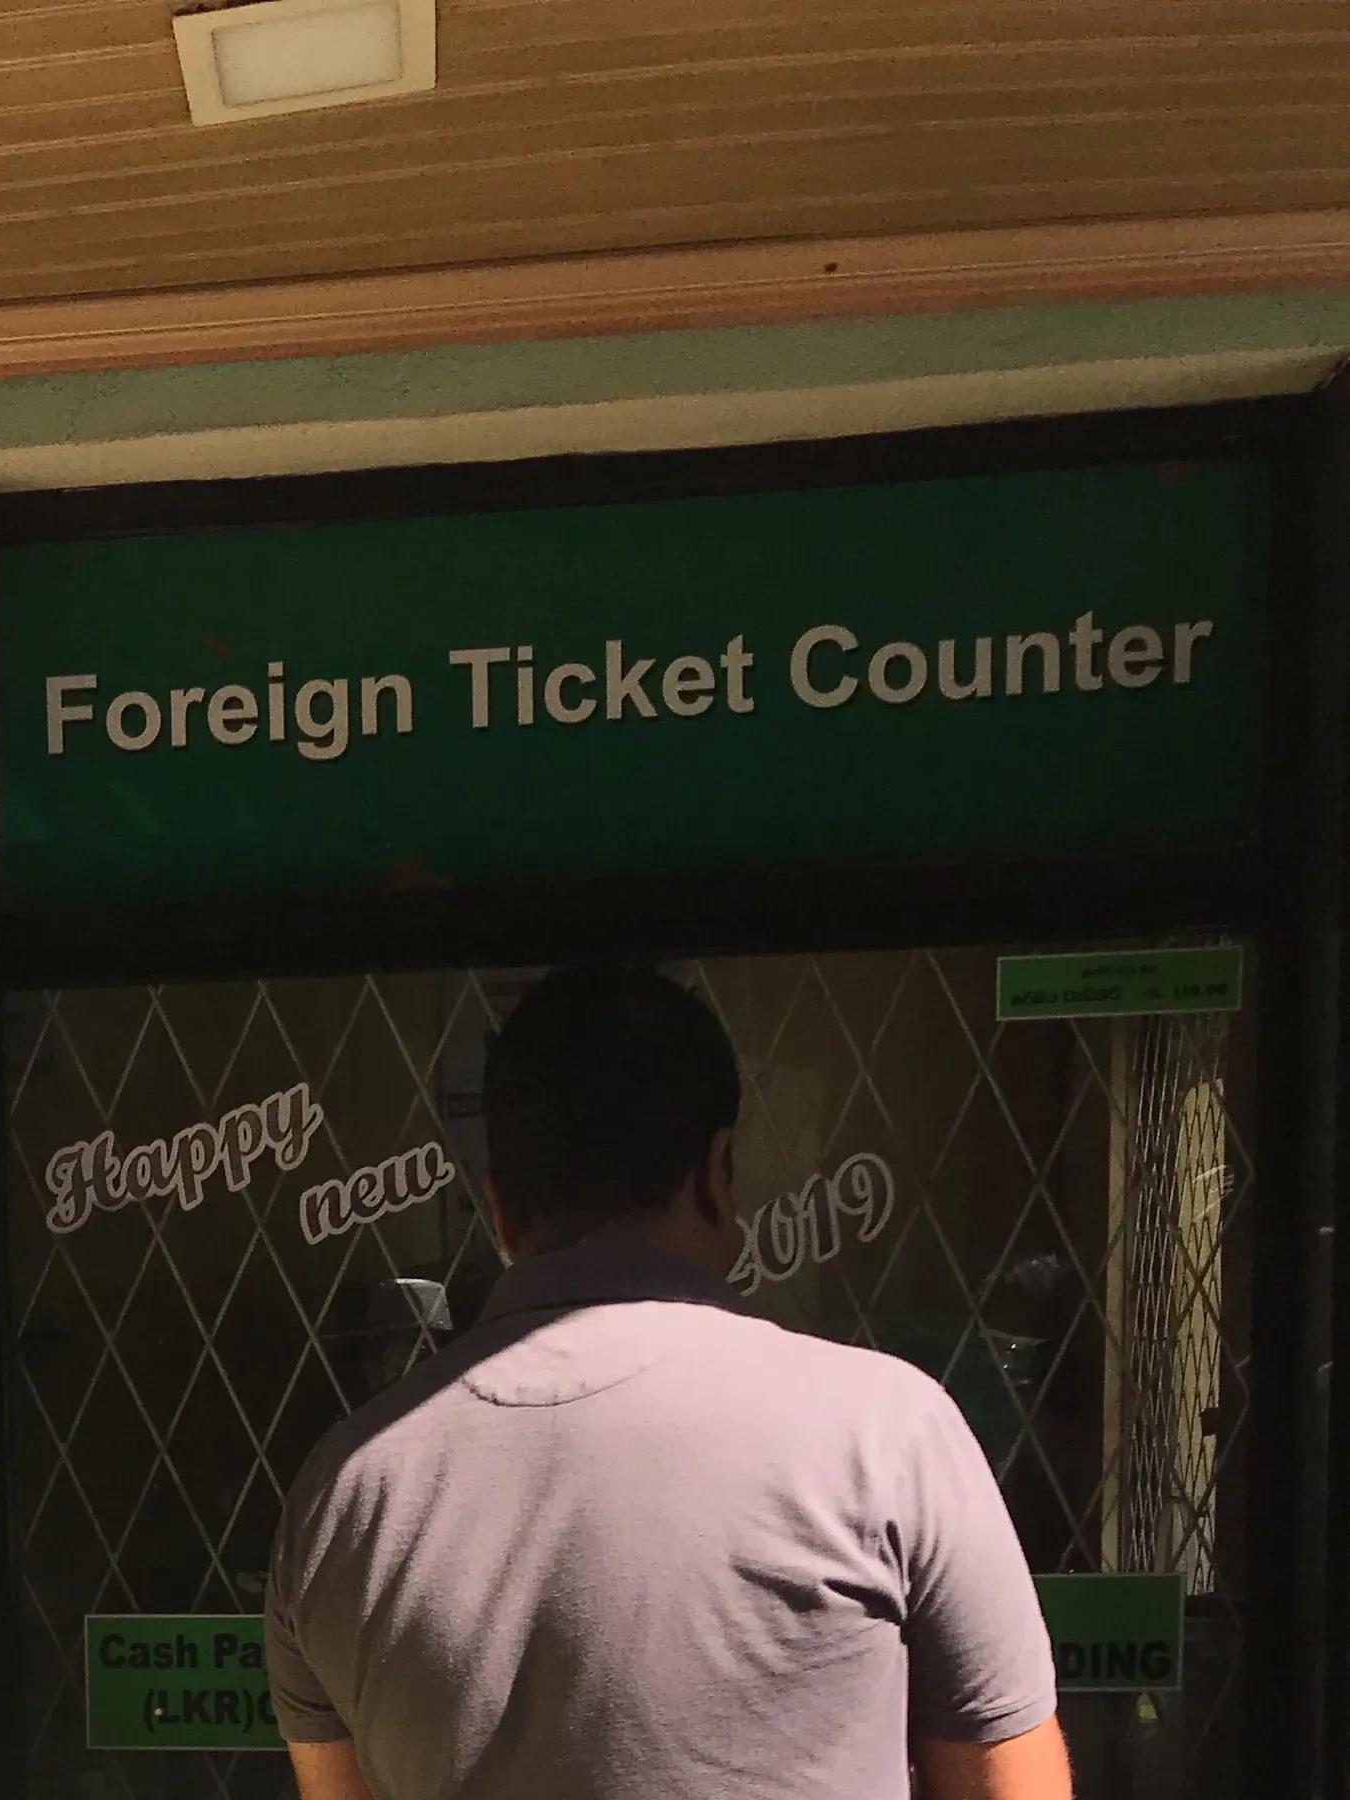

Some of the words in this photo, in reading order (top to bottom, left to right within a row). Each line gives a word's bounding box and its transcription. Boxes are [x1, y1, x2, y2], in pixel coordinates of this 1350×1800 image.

[46, 661, 413, 761] Foreign
[449, 634, 754, 729] Ticket
[789, 611, 1214, 709] Counter
[45, 1082, 324, 1234] Happy
[299, 1141, 456, 1245] new
[100, 1633, 199, 1669] Cash
[214, 1633, 269, 1677] Pa
